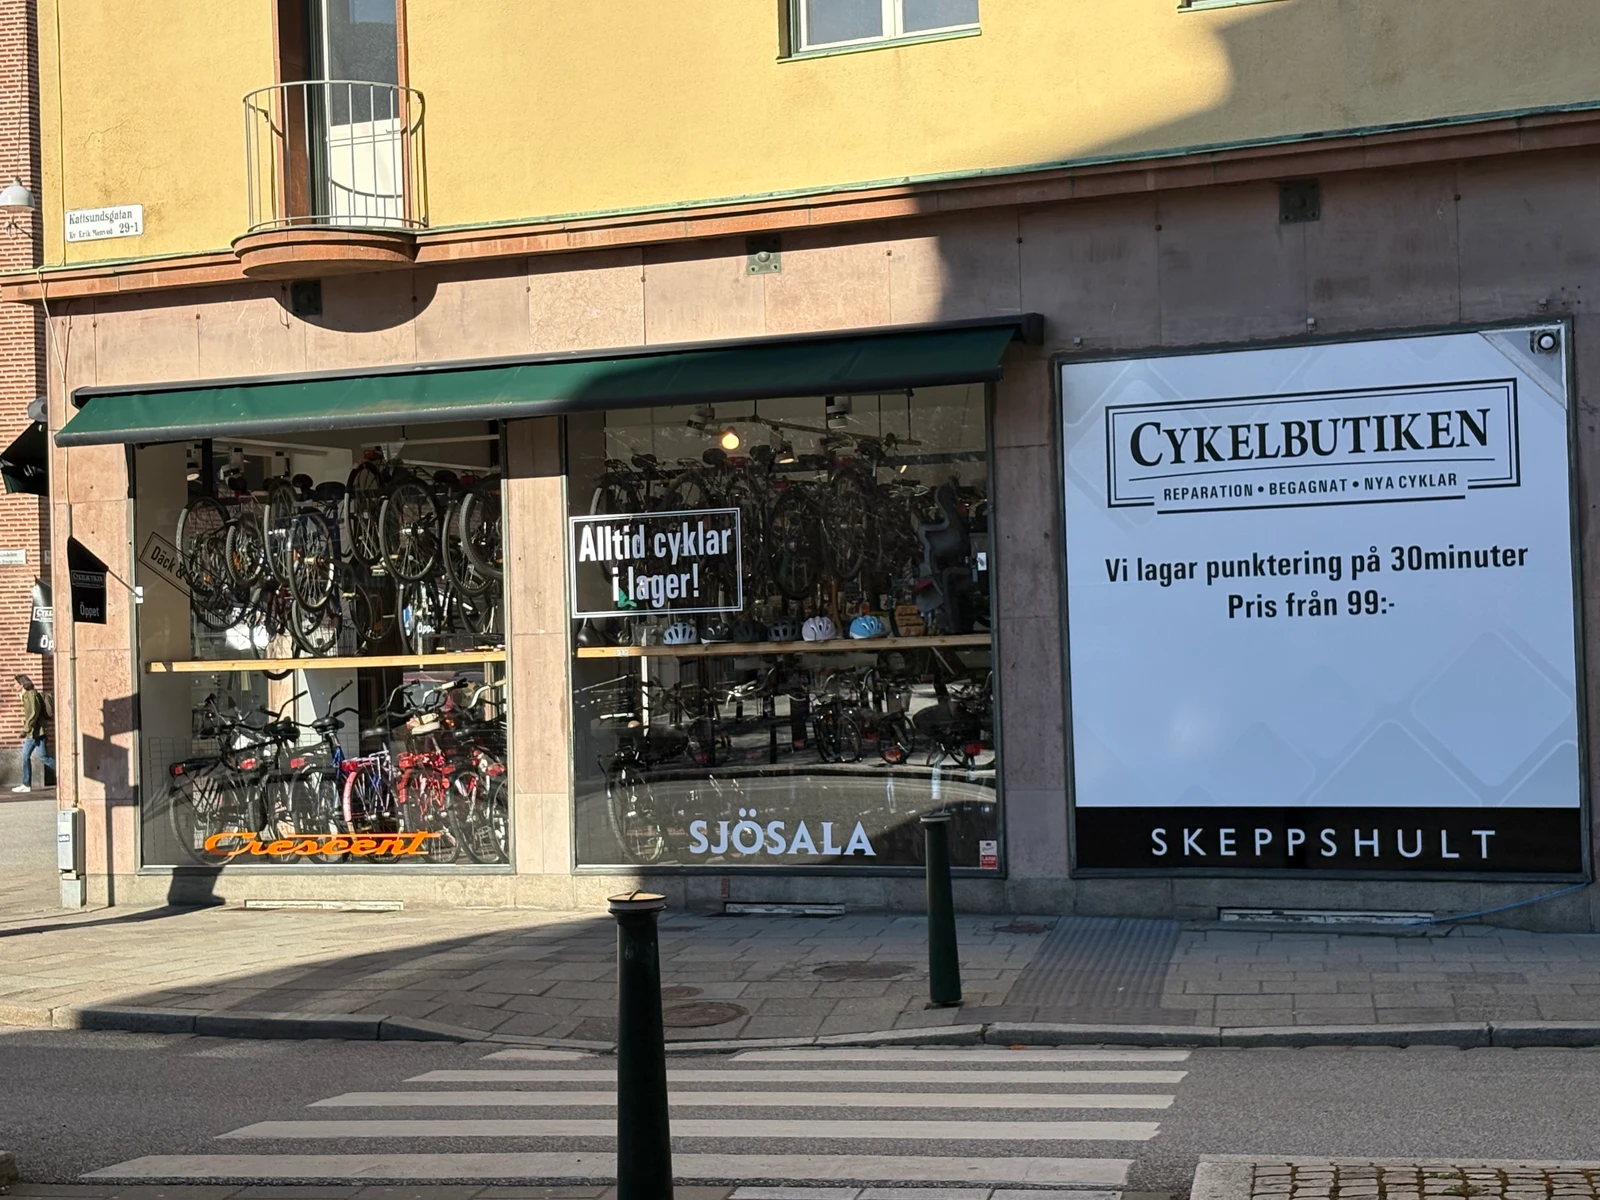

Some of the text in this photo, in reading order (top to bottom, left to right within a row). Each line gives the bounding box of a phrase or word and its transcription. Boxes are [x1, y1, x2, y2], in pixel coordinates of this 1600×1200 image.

[69, 210, 133, 224] Kattsundsgatan
[119, 222, 139, 233] 29-1
[1130, 408, 1491, 467] CYKELBUTIKEN
[1163, 472, 1457, 501] REPARATION BEGAGNAT NYA CYKLAR
[579, 521, 732, 565] Alltid cyklar
[151, 545, 176, 573] Däck
[175, 562, 188, 579] &
[1105, 544, 1529, 588] Vi lagar punktering på 30minuter
[612, 563, 699, 608] i lager!
[80, 602, 99, 618] Öppet
[1228, 590, 1395, 619] Pris från 99:-
[204, 831, 441, 857] Crescent
[689, 808, 877, 856] SJÖSALA
[1151, 828, 1496, 859] SKEPPSHULT
